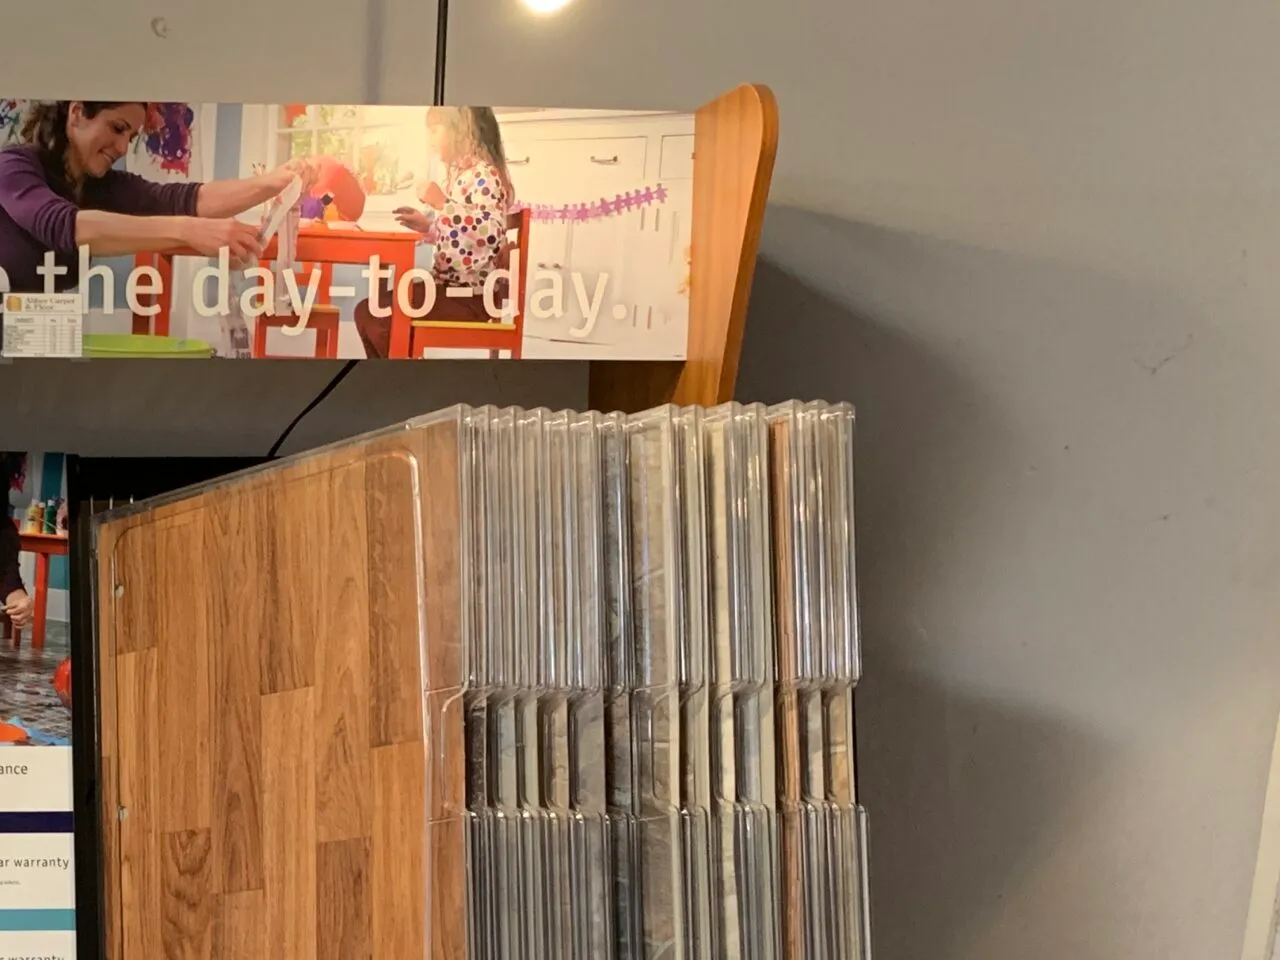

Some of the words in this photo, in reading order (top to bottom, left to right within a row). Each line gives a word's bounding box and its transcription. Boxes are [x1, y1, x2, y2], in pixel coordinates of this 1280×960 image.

[38, 245, 163, 316] the
[193, 245, 628, 340] day-to-day.
[13, 857, 70, 870] warranty
